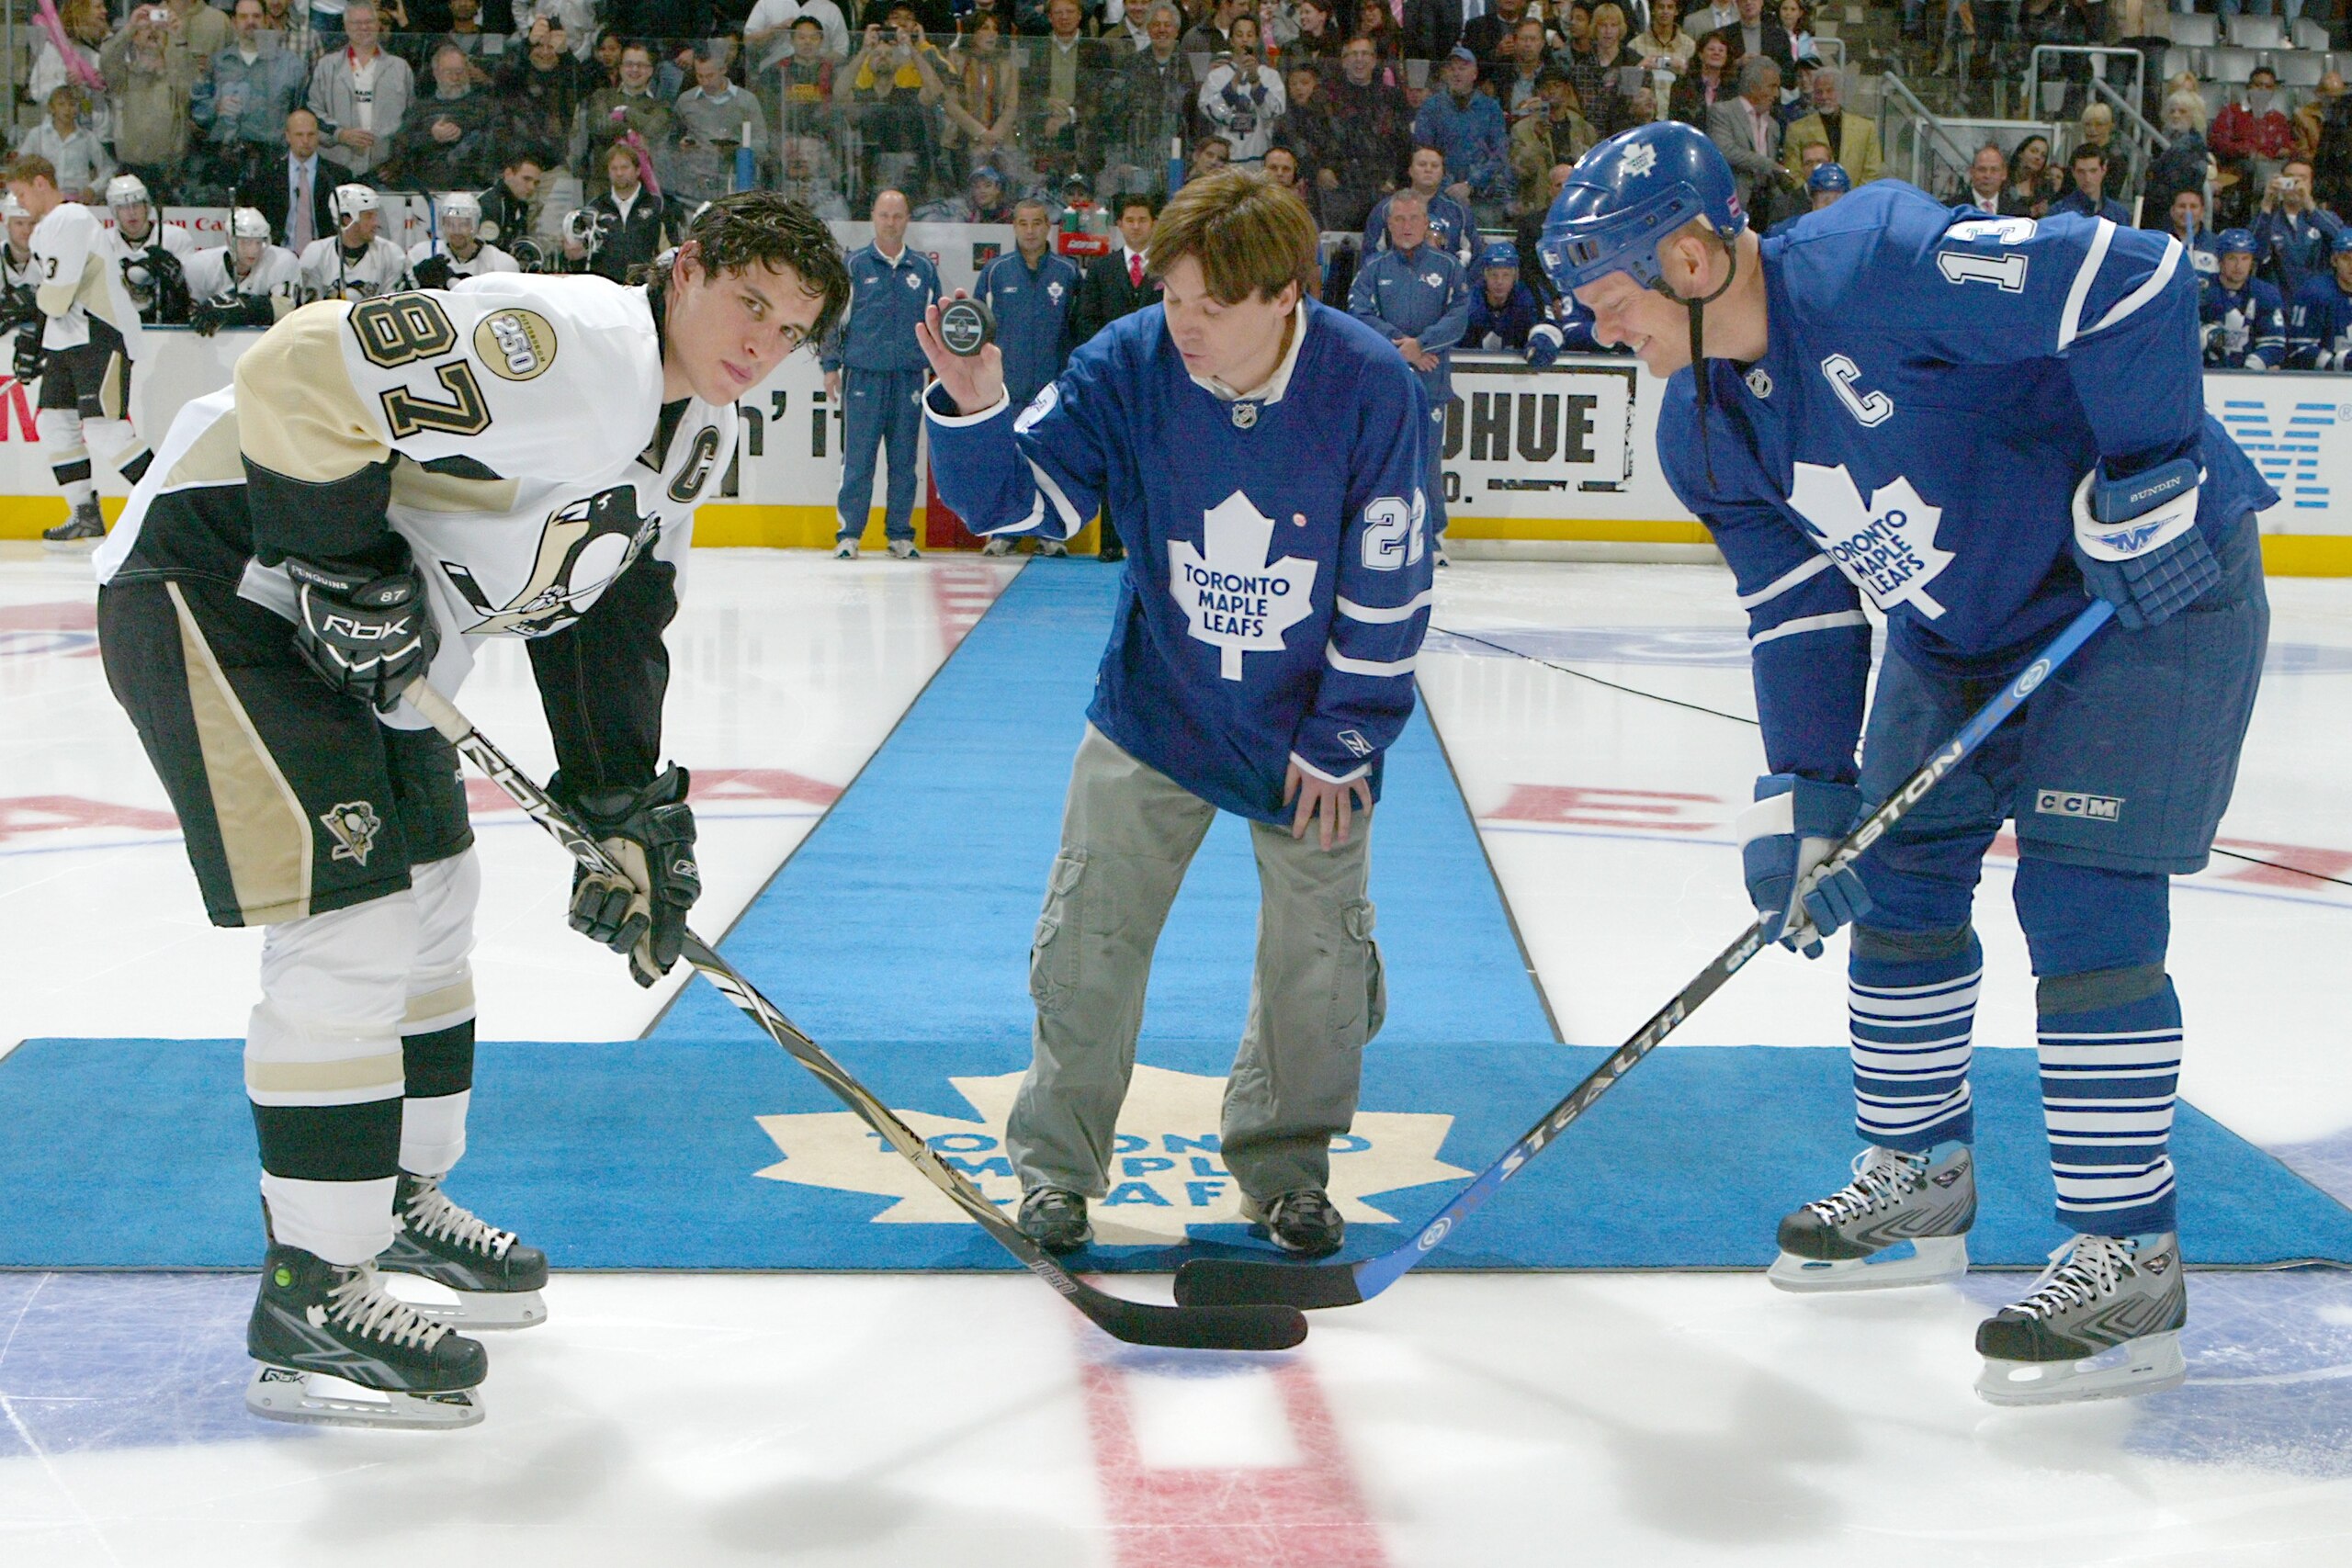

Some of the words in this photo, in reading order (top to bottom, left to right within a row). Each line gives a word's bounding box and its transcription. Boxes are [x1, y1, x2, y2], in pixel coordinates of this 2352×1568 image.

[486, 313, 539, 374] 250
[347, 292, 492, 441] 87
[1821, 353, 1894, 427] C
[667, 424, 720, 503] C
[290, 564, 349, 591] PENGUINS
[1849, 534, 1912, 581] MAPLE
[1868, 553, 1925, 595] LEAFS
[380, 590, 406, 604] 87
[1183, 563, 1290, 596] TORONTO
[1198, 589, 1268, 617] MAPLE
[1204, 612, 1263, 637] LEAFS
[2040, 794, 2118, 819] CCM
[1500, 999, 1686, 1181] STEALTH
